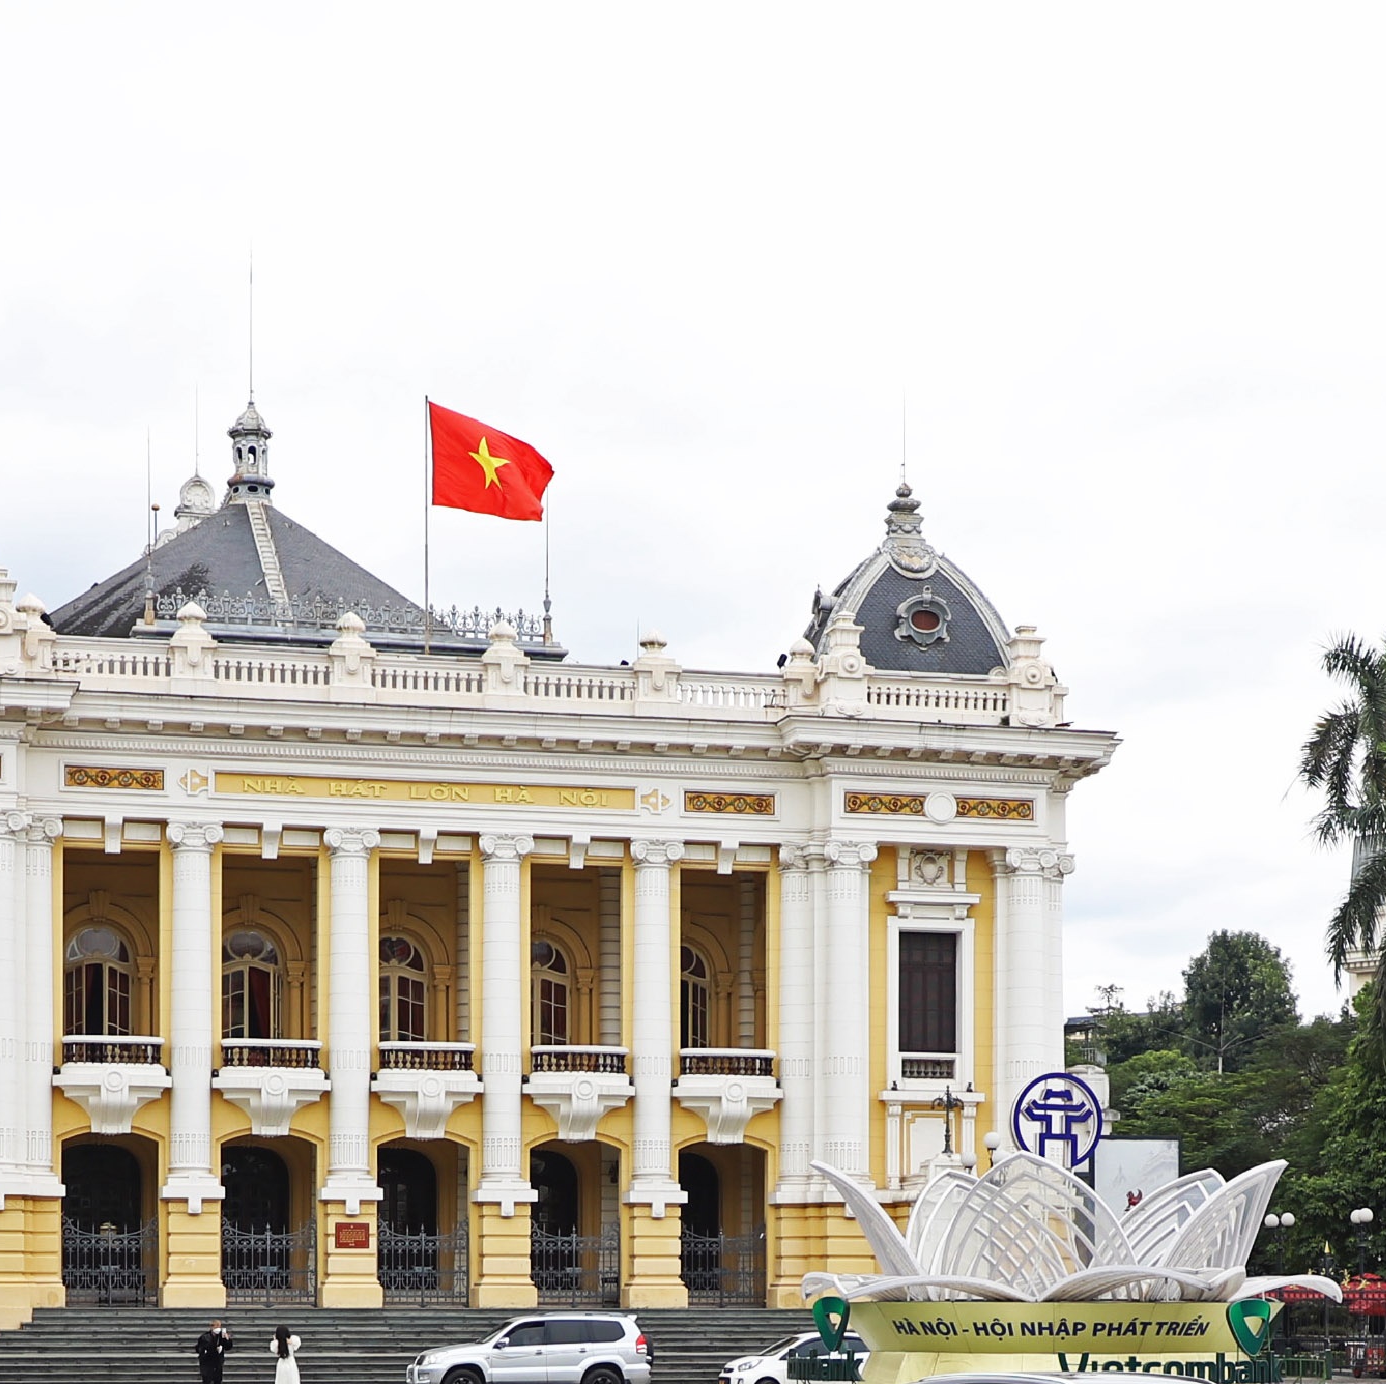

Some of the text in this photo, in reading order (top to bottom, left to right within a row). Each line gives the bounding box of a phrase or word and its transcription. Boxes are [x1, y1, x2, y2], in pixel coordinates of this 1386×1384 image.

[242, 776, 305, 795] NHÀ
[329, 779, 387, 798] HÁT
[494, 785, 534, 804] HÀ
[559, 788, 608, 808] NỘI
[892, 1317, 921, 1336] HÀ
[919, 1317, 958, 1340] NỘI
[973, 1317, 1014, 1341] HỘI
[1020, 1317, 1087, 1340] NHẬP
[1092, 1317, 1152, 1337] PHÁT
[1155, 1314, 1211, 1336] TRIỂN
